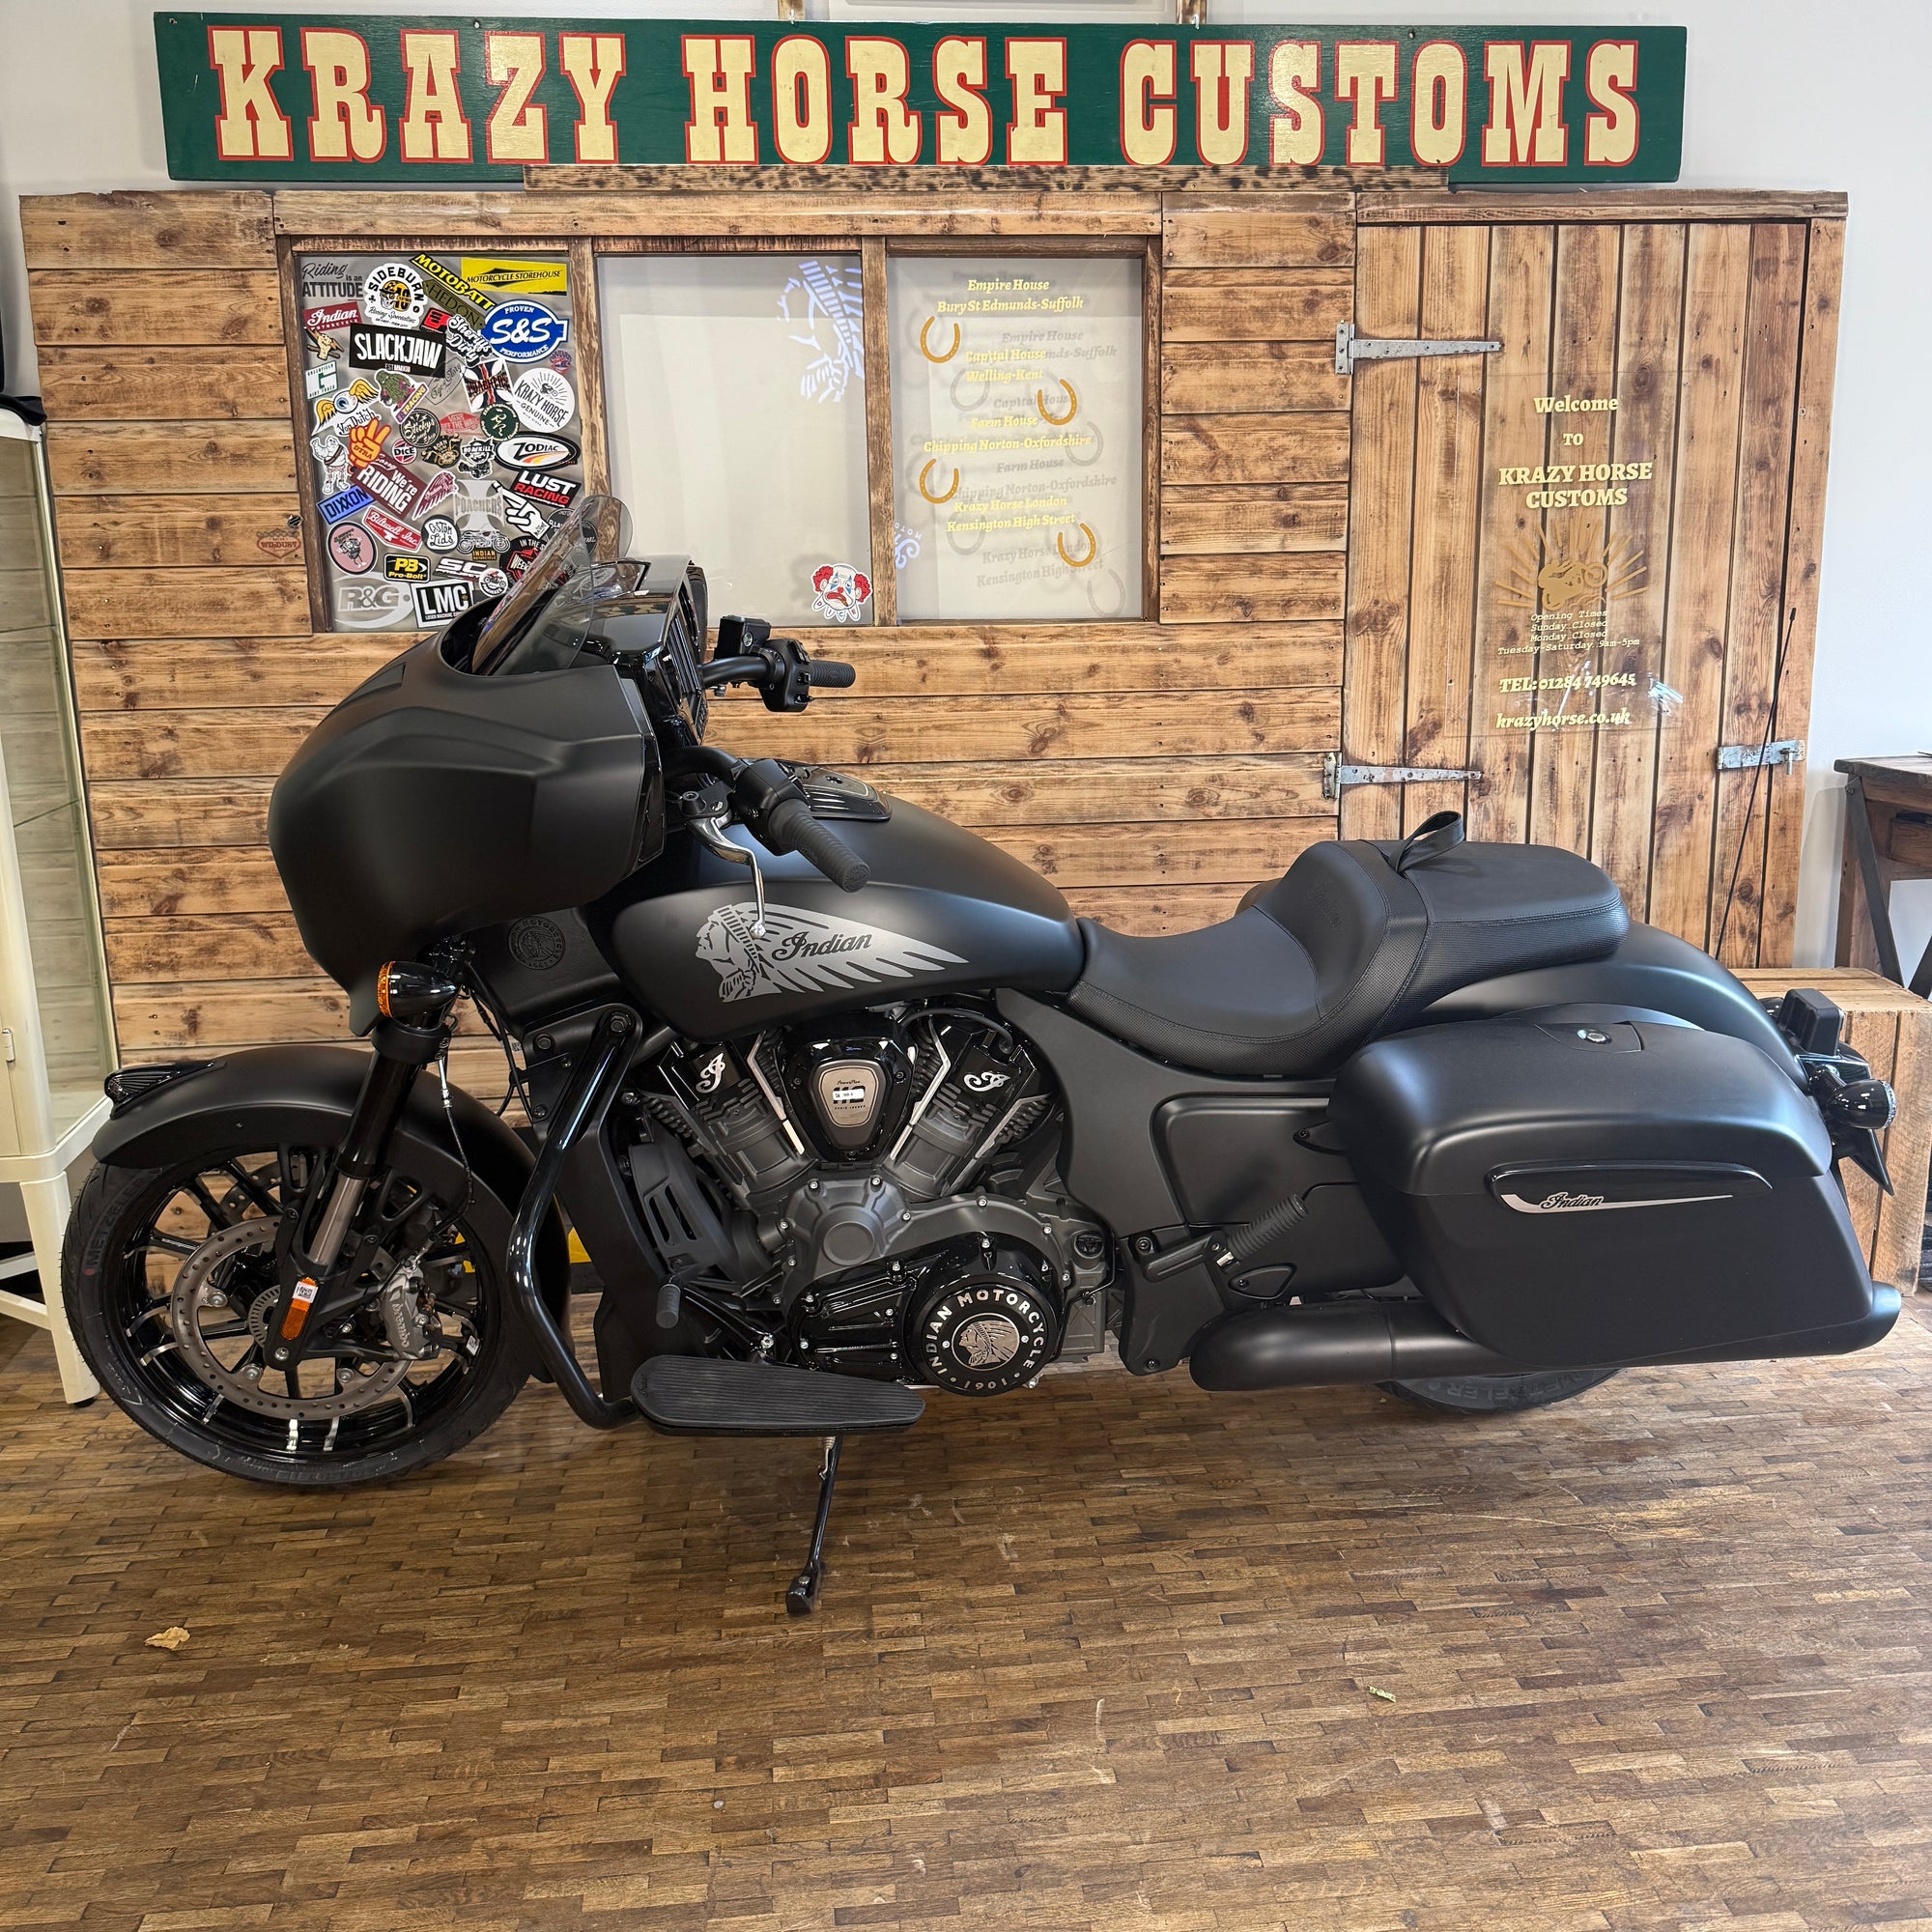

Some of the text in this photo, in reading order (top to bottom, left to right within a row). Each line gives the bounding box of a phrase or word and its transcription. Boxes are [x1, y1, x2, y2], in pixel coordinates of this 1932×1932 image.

[207, 25, 1639, 167] KRAZY HORSE CUSTOMS
[302, 262, 348, 279] Riding
[467, 270, 561, 283] MOTORCYCLE STOREHOUSE
[302, 282, 363, 298] ATTITUDE
[368, 267, 424, 300] SIDEBURN
[415, 254, 496, 310] MOTOBATT
[967, 278, 1011, 294] Empire
[1012, 279, 1049, 291] House
[429, 283, 480, 327] HEDON
[504, 306, 534, 315] PROVEN
[937, 297, 1084, 315] Bury St Edmunds-Suffolk
[307, 309, 358, 326] Indian
[490, 318, 554, 345] S&S
[355, 333, 442, 369] SLACKJAW
[450, 333, 480, 362] Dirty
[499, 345, 550, 358] PERFORMANCE
[1010, 349, 1046, 360] House
[966, 370, 1043, 384] Welling-Kent
[515, 380, 542, 405] KRAZY
[542, 401, 569, 427] HORSE
[1533, 395, 1619, 412] Welcome
[350, 408, 376, 428] Dutch
[521, 403, 549, 425] GENUINE
[970, 415, 1038, 428] Farm House
[923, 435, 1092, 454] Chipping Norton-Oxfordshire
[1563, 433, 1583, 445] TO
[353, 444, 373, 460] DTRA
[394, 447, 415, 457] DICE
[513, 442, 559, 461] ZODIAC
[392, 470, 417, 496] We're
[519, 470, 575, 495] LUST
[1498, 463, 1653, 486] KRAZY HORSE
[356, 465, 412, 512] RIDING
[513, 483, 570, 504] RACING
[324, 488, 368, 518] DIXXON
[455, 494, 503, 518] POACHERS
[953, 497, 1067, 514] Krazy Horse London
[1525, 488, 1628, 509] CUSTOMS
[367, 511, 404, 535] Biltwell
[947, 513, 1076, 532] Kensington High Street
[520, 539, 527, 548] IN
[527, 539, 540, 548] THE
[394, 557, 419, 573] PB
[438, 557, 486, 572] SC
[339, 585, 400, 611] R&G
[420, 585, 469, 614] LMC
[817, 601, 856, 617] DICE
[1530, 610, 1608, 623] Opening Times
[1496, 707, 1631, 731] krazyhorse.co.uk
[772, 931, 872, 961] Indian
[1540, 1192, 1605, 1209] Indian
[925, 1289, 1045, 1375] INDIAN MOTORCYCLE
